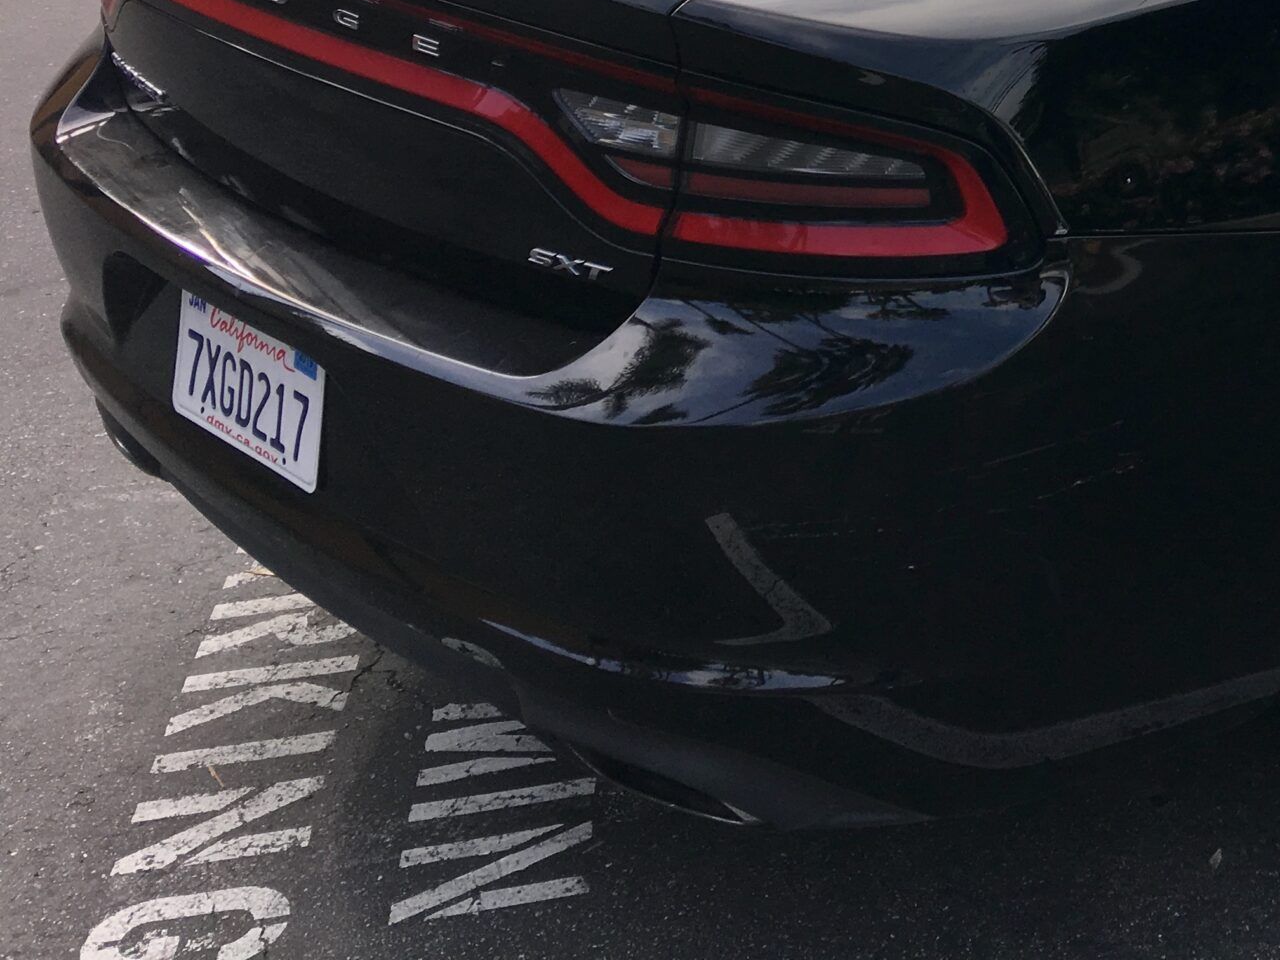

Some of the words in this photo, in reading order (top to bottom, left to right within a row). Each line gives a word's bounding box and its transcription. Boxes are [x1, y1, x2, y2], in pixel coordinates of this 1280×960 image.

[527, 247, 613, 282] SXT
[208, 307, 296, 373] California
[187, 328, 310, 462] 7XGD217
